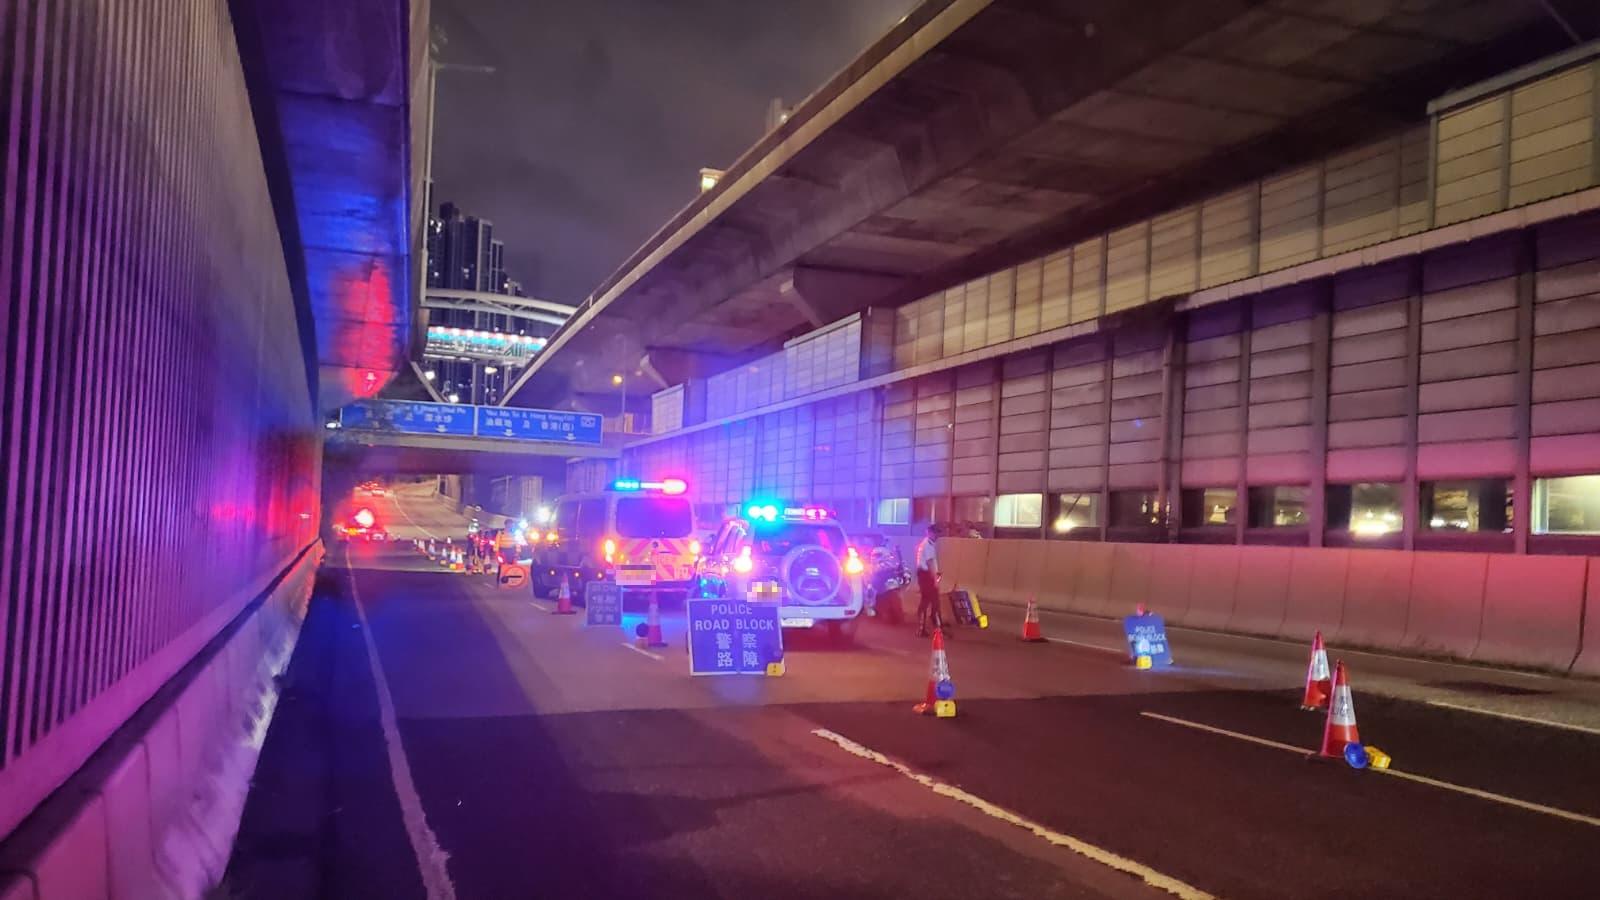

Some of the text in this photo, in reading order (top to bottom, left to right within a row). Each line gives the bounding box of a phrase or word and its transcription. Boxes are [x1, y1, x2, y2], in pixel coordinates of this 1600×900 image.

[711, 604, 753, 616] POLICE
[695, 619, 730, 631] ROAD
[735, 618, 775, 631] BLOCK
